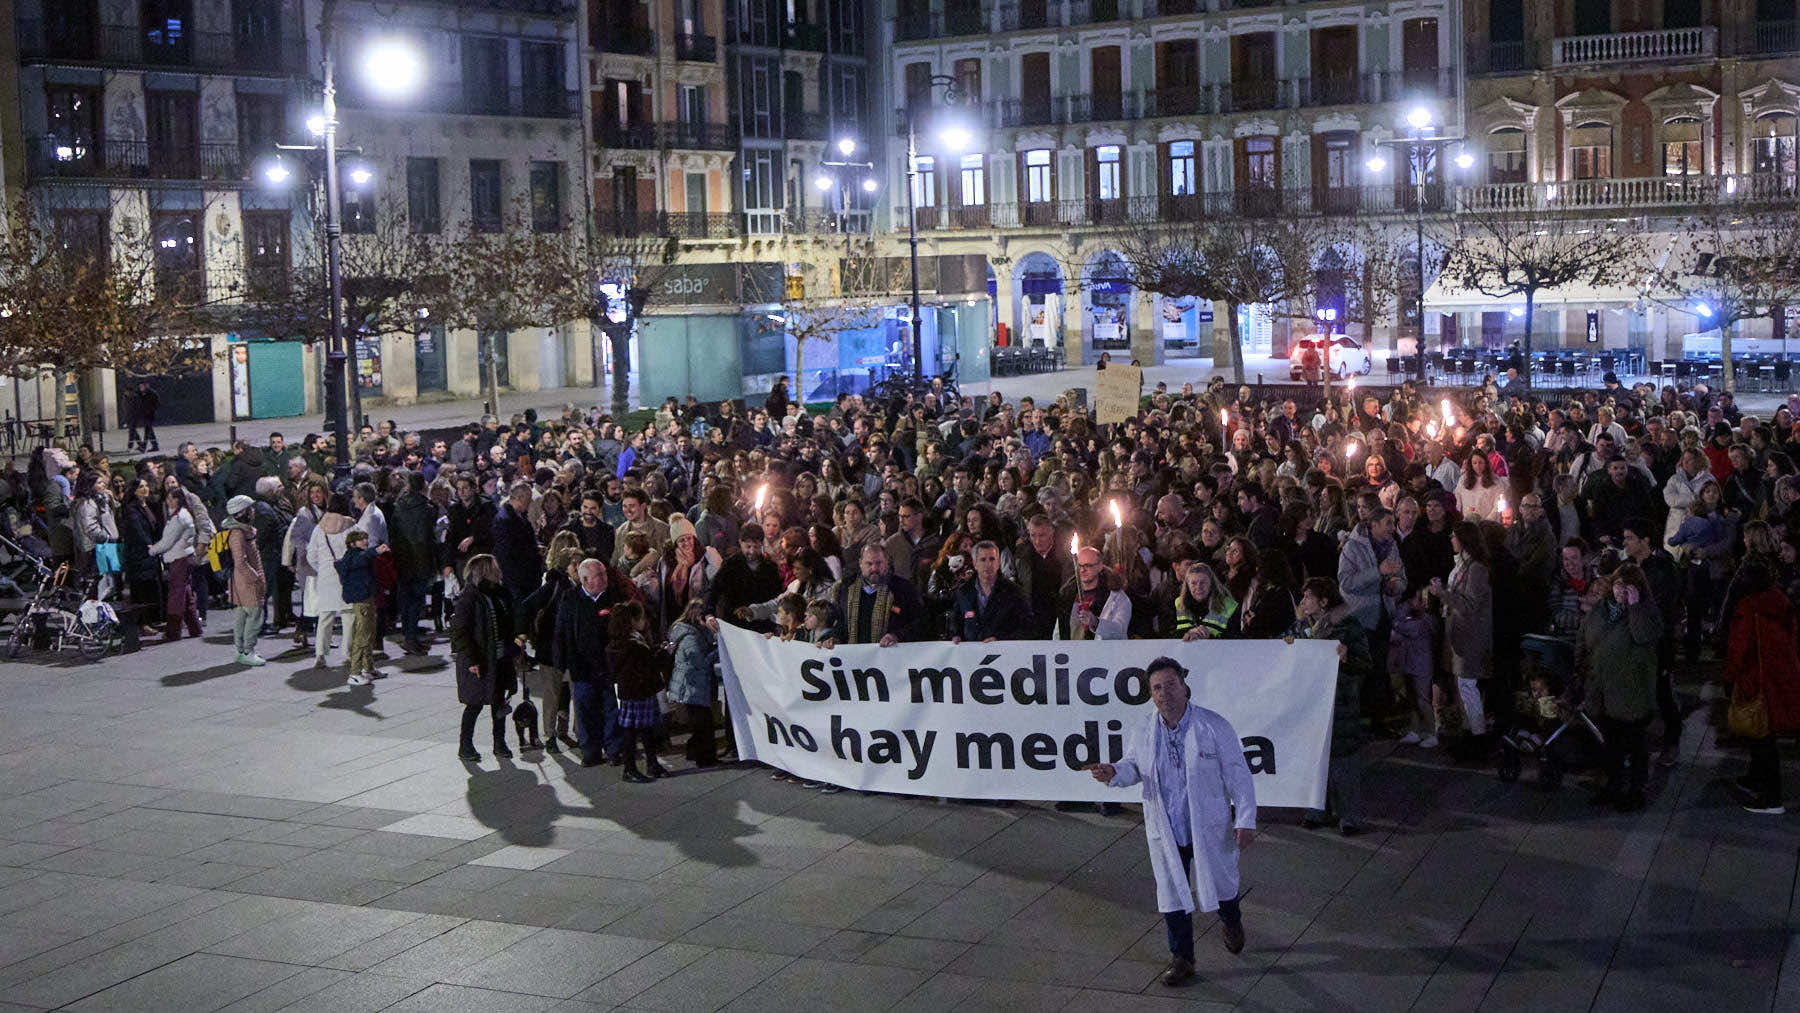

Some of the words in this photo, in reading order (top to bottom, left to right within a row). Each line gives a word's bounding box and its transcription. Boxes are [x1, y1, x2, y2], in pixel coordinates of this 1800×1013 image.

[801, 657, 890, 702] Sin
[763, 712, 818, 752] no
[830, 715, 937, 780] hay
[955, 719, 1277, 775] media
